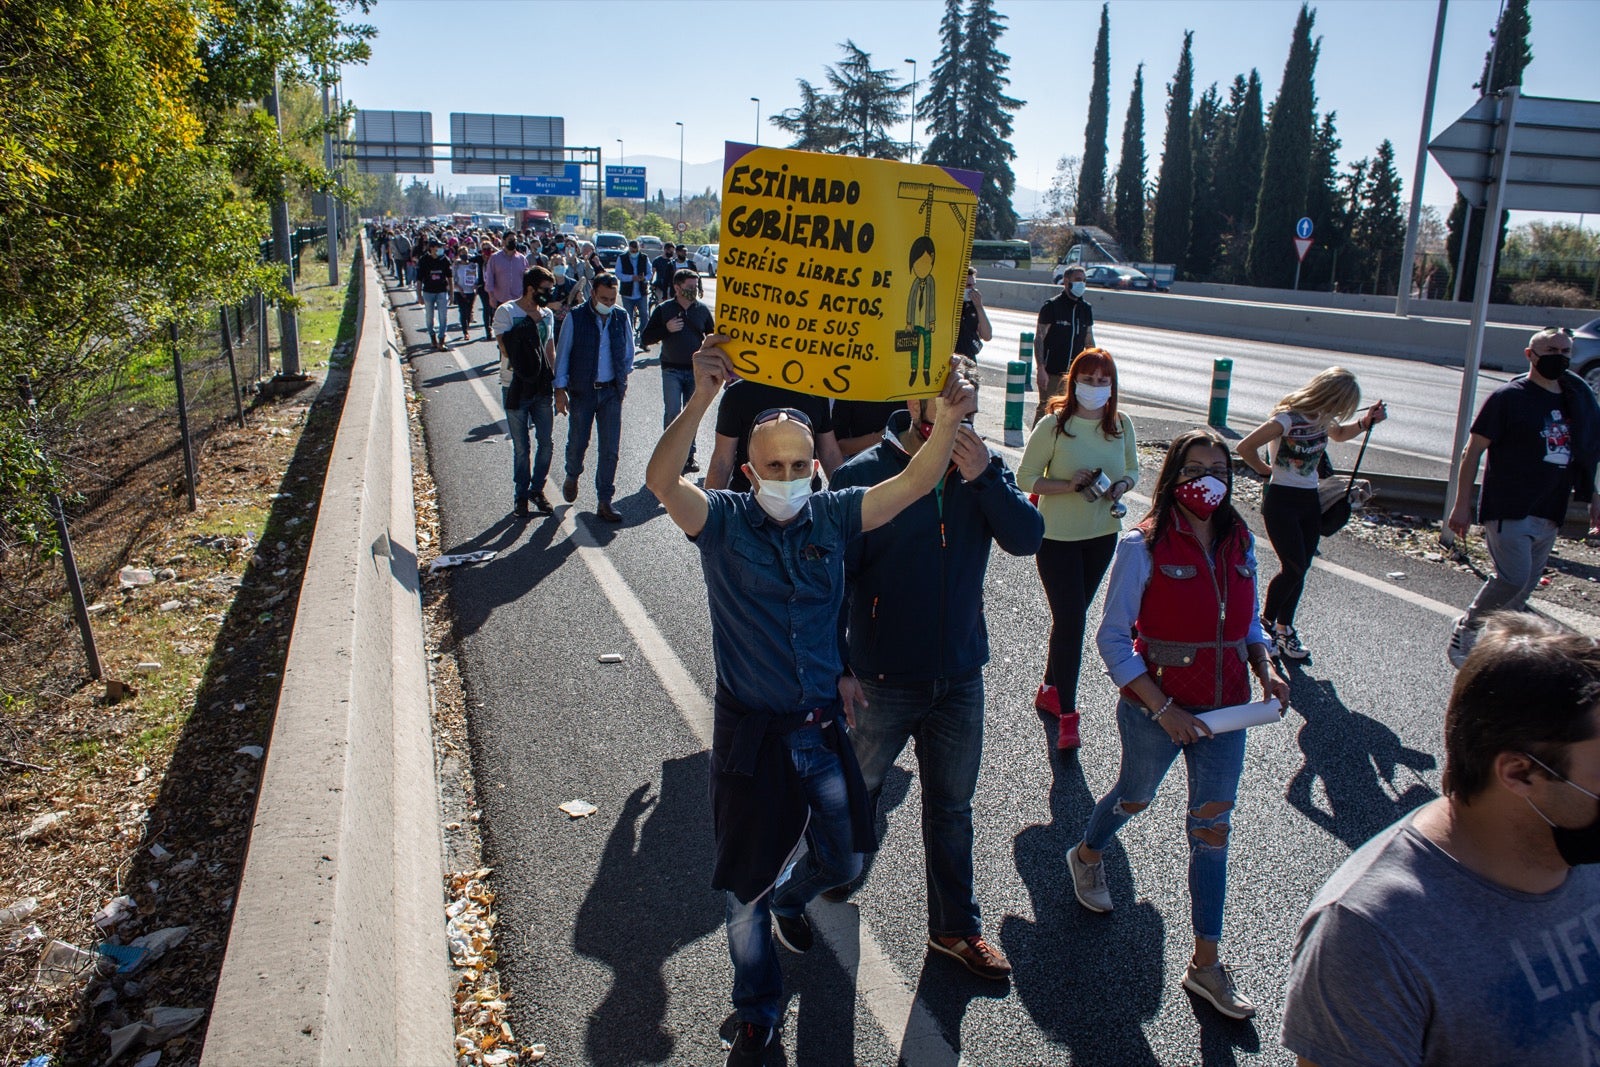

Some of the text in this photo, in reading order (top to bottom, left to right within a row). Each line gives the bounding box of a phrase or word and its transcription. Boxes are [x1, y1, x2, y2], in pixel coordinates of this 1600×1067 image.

[727, 164, 861, 205] ESTIMADO
[727, 205, 875, 253] GOBIERNO
[724, 246, 893, 288] SERÉIS LIBRES DE
[721, 276, 884, 320] VUESTROS ACTOS,
[720, 303, 860, 336] PERO NO DE SUS
[717, 324, 880, 361] CONSECUENCIAS.
